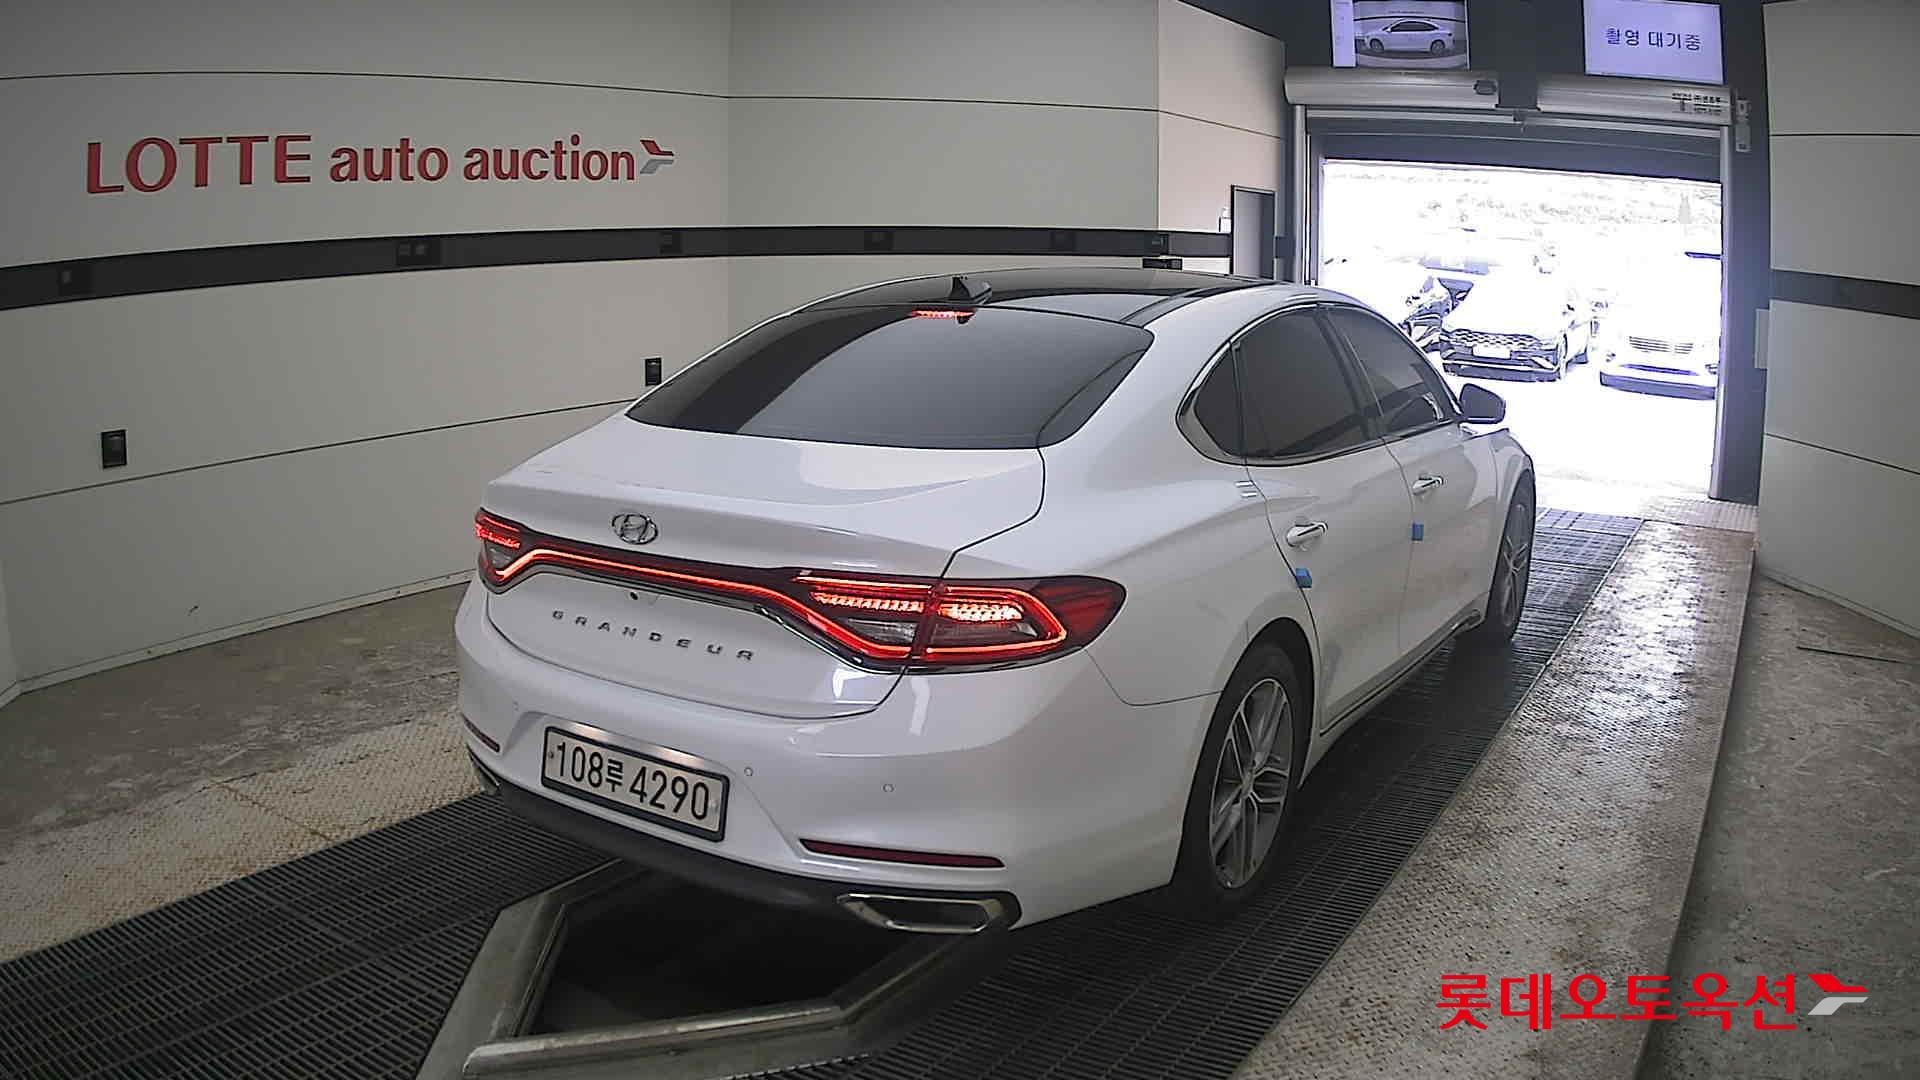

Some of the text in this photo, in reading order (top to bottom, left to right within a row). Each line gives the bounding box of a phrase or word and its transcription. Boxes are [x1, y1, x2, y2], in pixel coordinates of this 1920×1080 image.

[1607, 27, 1701, 51] 촬영 대기중
[86, 134, 636, 194] LOTTE auto auction
[552, 610, 754, 661] GRANDEUR
[557, 741, 709, 820] 108루 4290
